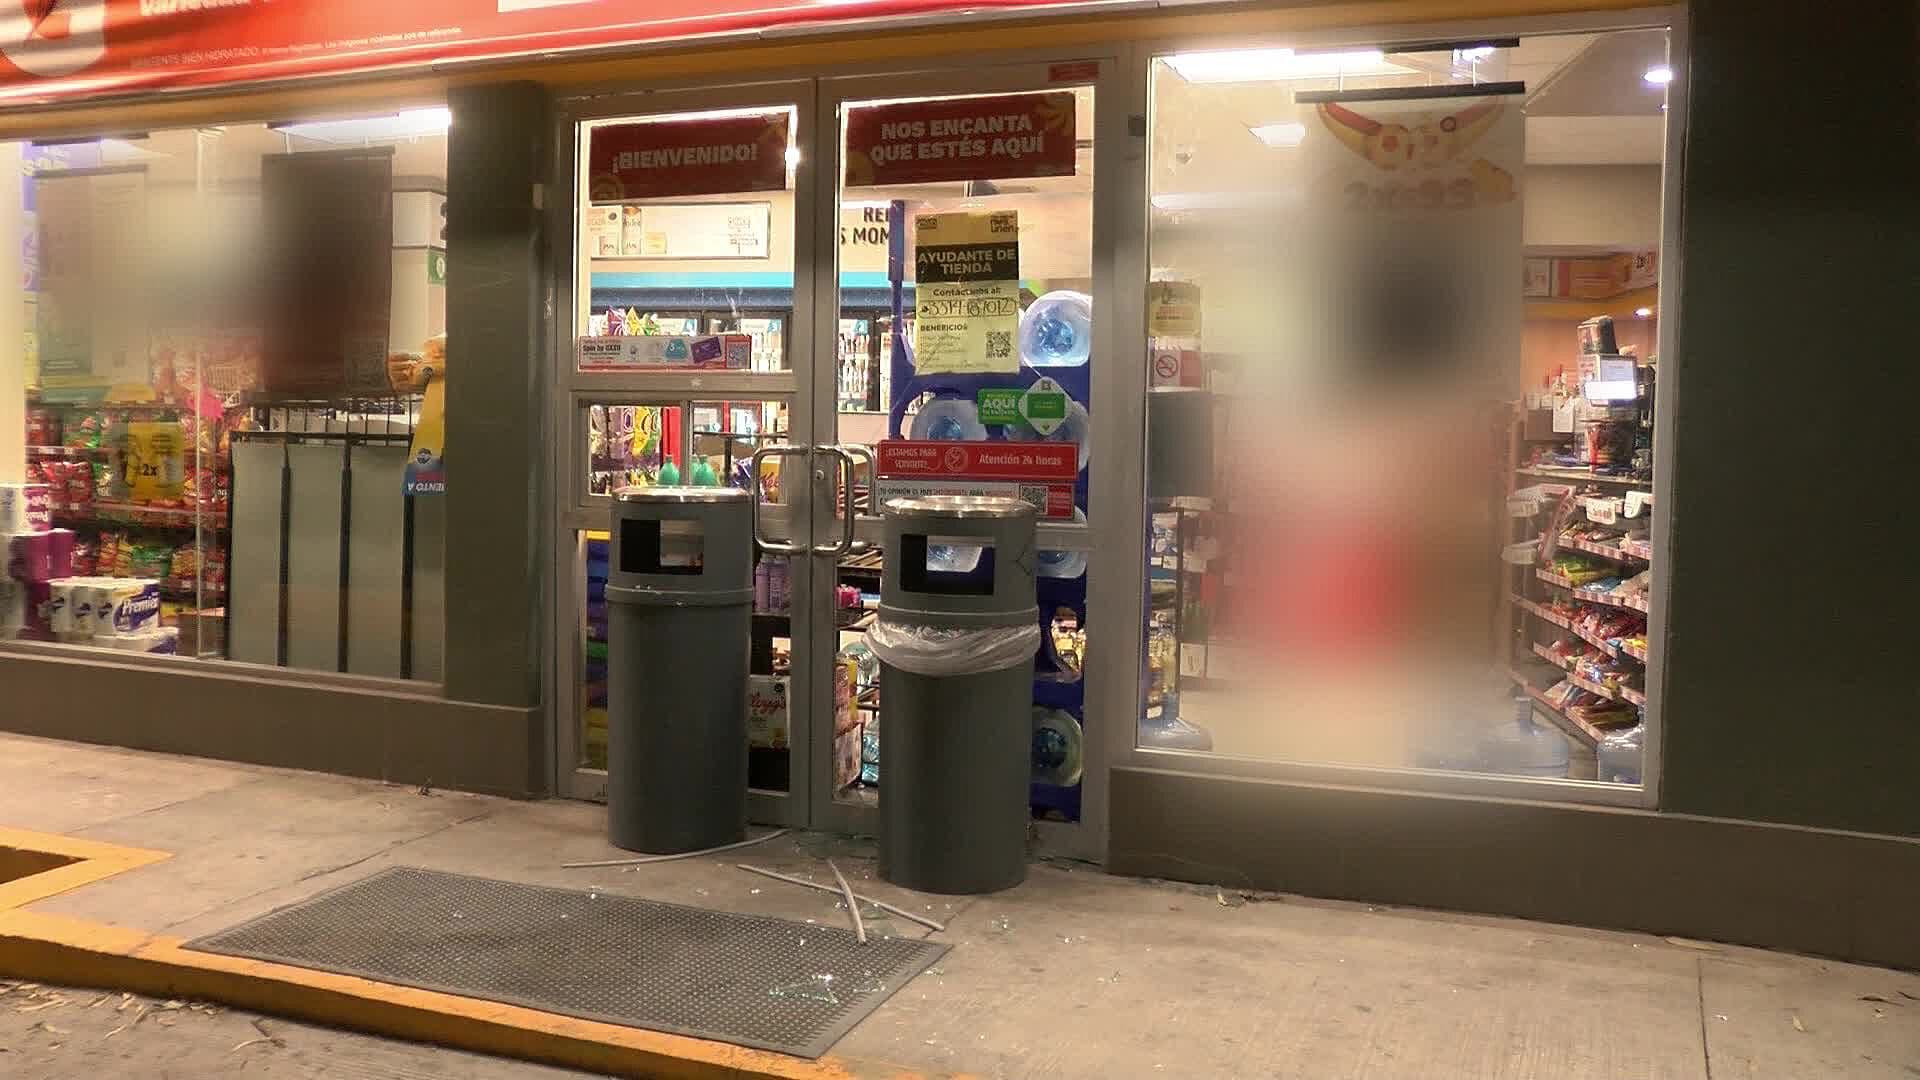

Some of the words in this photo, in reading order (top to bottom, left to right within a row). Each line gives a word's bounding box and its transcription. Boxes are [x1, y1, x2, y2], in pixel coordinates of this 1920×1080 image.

[881, 121, 925, 140] NOS
[930, 114, 1032, 136] ENCANTA
[612, 143, 758, 174] ¡BIENVENIDO!
[870, 143, 913, 166] QUE
[918, 137, 985, 159] ESTÉS
[992, 131, 1044, 158] AQUÍ
[917, 250, 993, 264] AYUDANTE
[996, 248, 1017, 261] DE
[940, 263, 993, 275] TIENDA
[979, 453, 1020, 465] Atención
[1022, 455, 1033, 465] 24
[1035, 454, 1062, 465] horas
